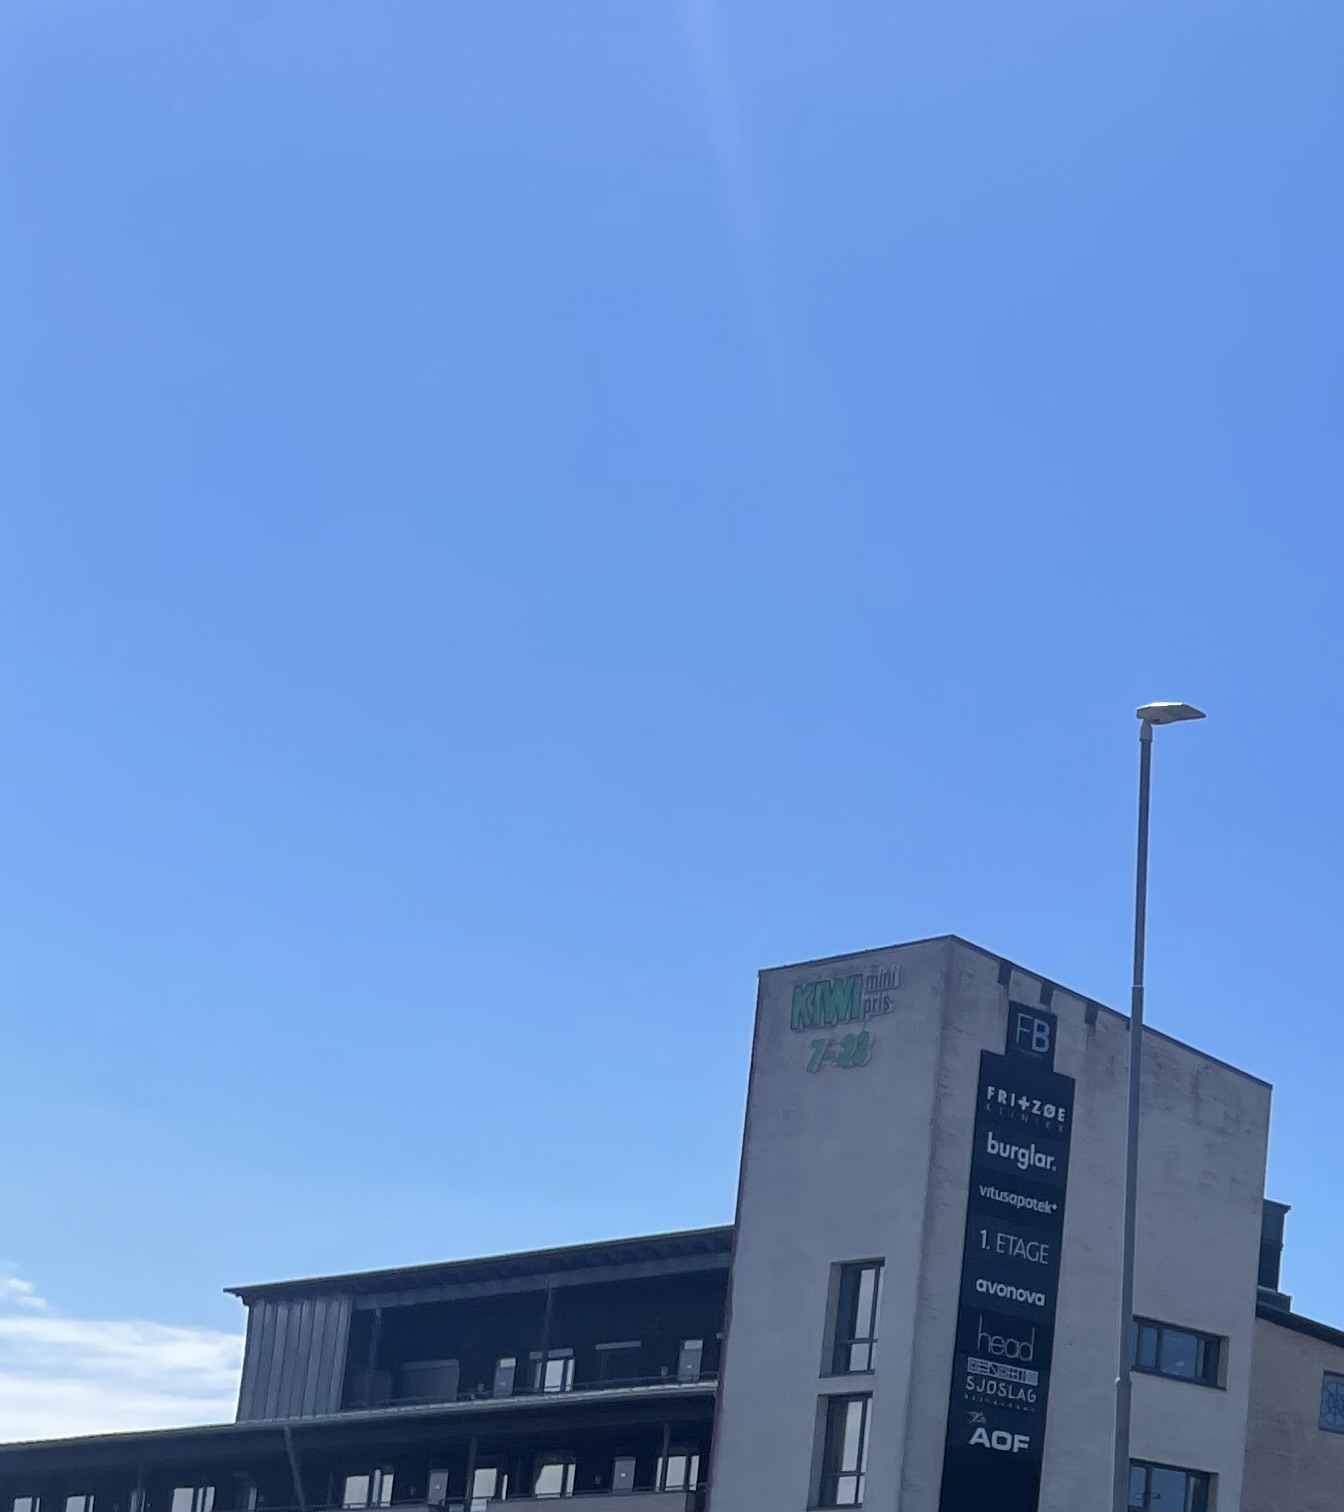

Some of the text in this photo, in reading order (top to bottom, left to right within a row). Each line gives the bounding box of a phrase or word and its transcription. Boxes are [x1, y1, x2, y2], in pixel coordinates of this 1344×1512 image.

[790, 973, 863, 1031] KIWI
[1015, 1012, 1051, 1053] FB
[979, 1229, 1050, 1265] 1. ETAGE
[976, 1278, 1046, 1307] avonova
[977, 1314, 1036, 1362] head
[968, 1427, 1031, 1453] AOF
